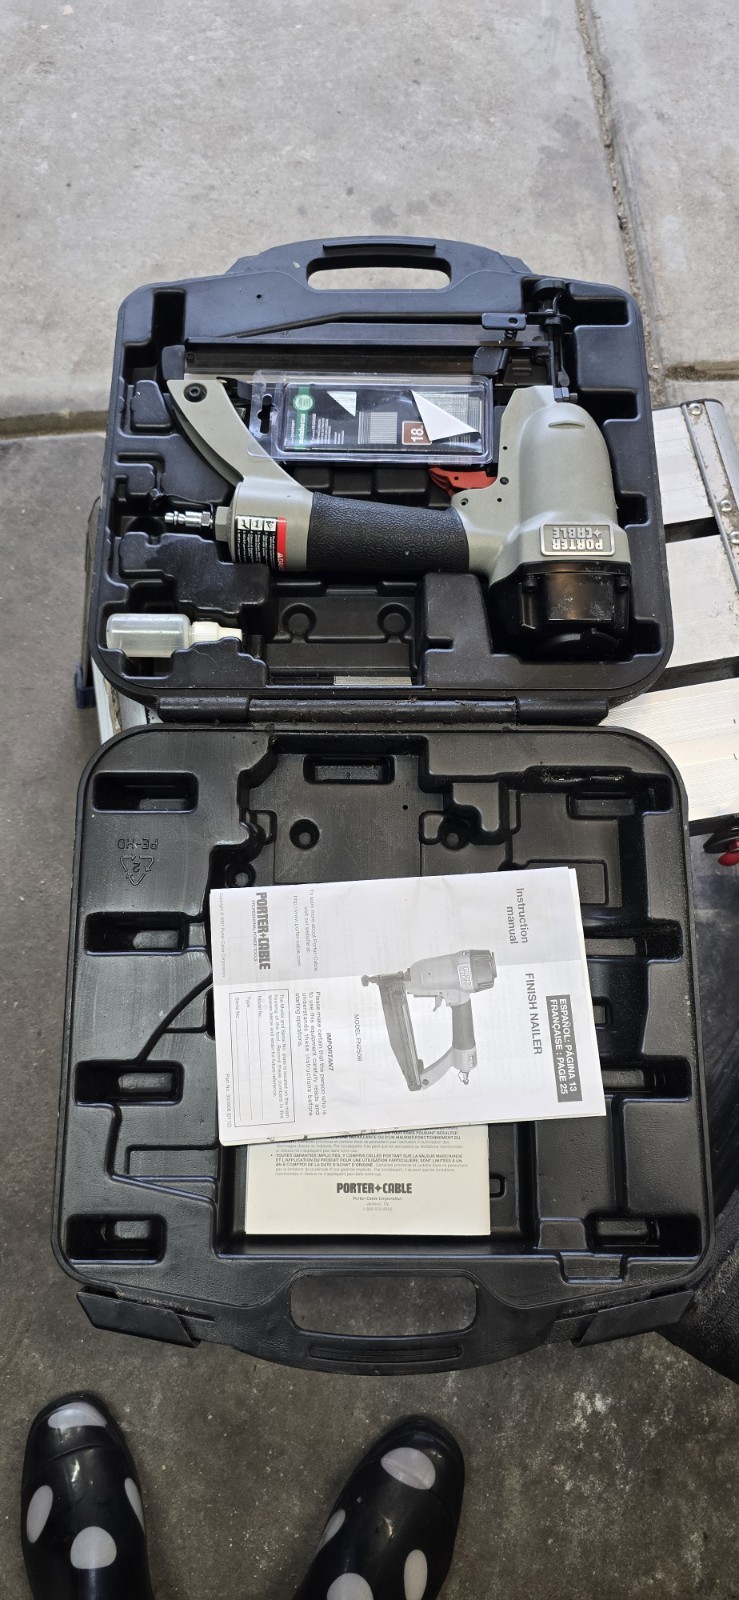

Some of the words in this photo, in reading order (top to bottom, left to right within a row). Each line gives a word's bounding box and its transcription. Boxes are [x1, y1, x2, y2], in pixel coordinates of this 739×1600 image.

[411, 428, 423, 442] 18
[552, 539, 603, 550] PORTER
[117, 839, 158, 850] PE-HD
[506, 906, 518, 944] manual
[516, 888, 529, 944] Instruction
[525, 973, 537, 1009] FINISH
[530, 1013, 543, 1055] NAILER
[550, 1000, 562, 1050] FRANÇAISE
[559, 998, 572, 1042] ESPAÑOL:
[557, 1057, 567, 1082] PAGE
[565, 1045, 576, 1079] PÁGINA
[560, 1084, 568, 1094] 25
[569, 1081, 577, 1092] 13
